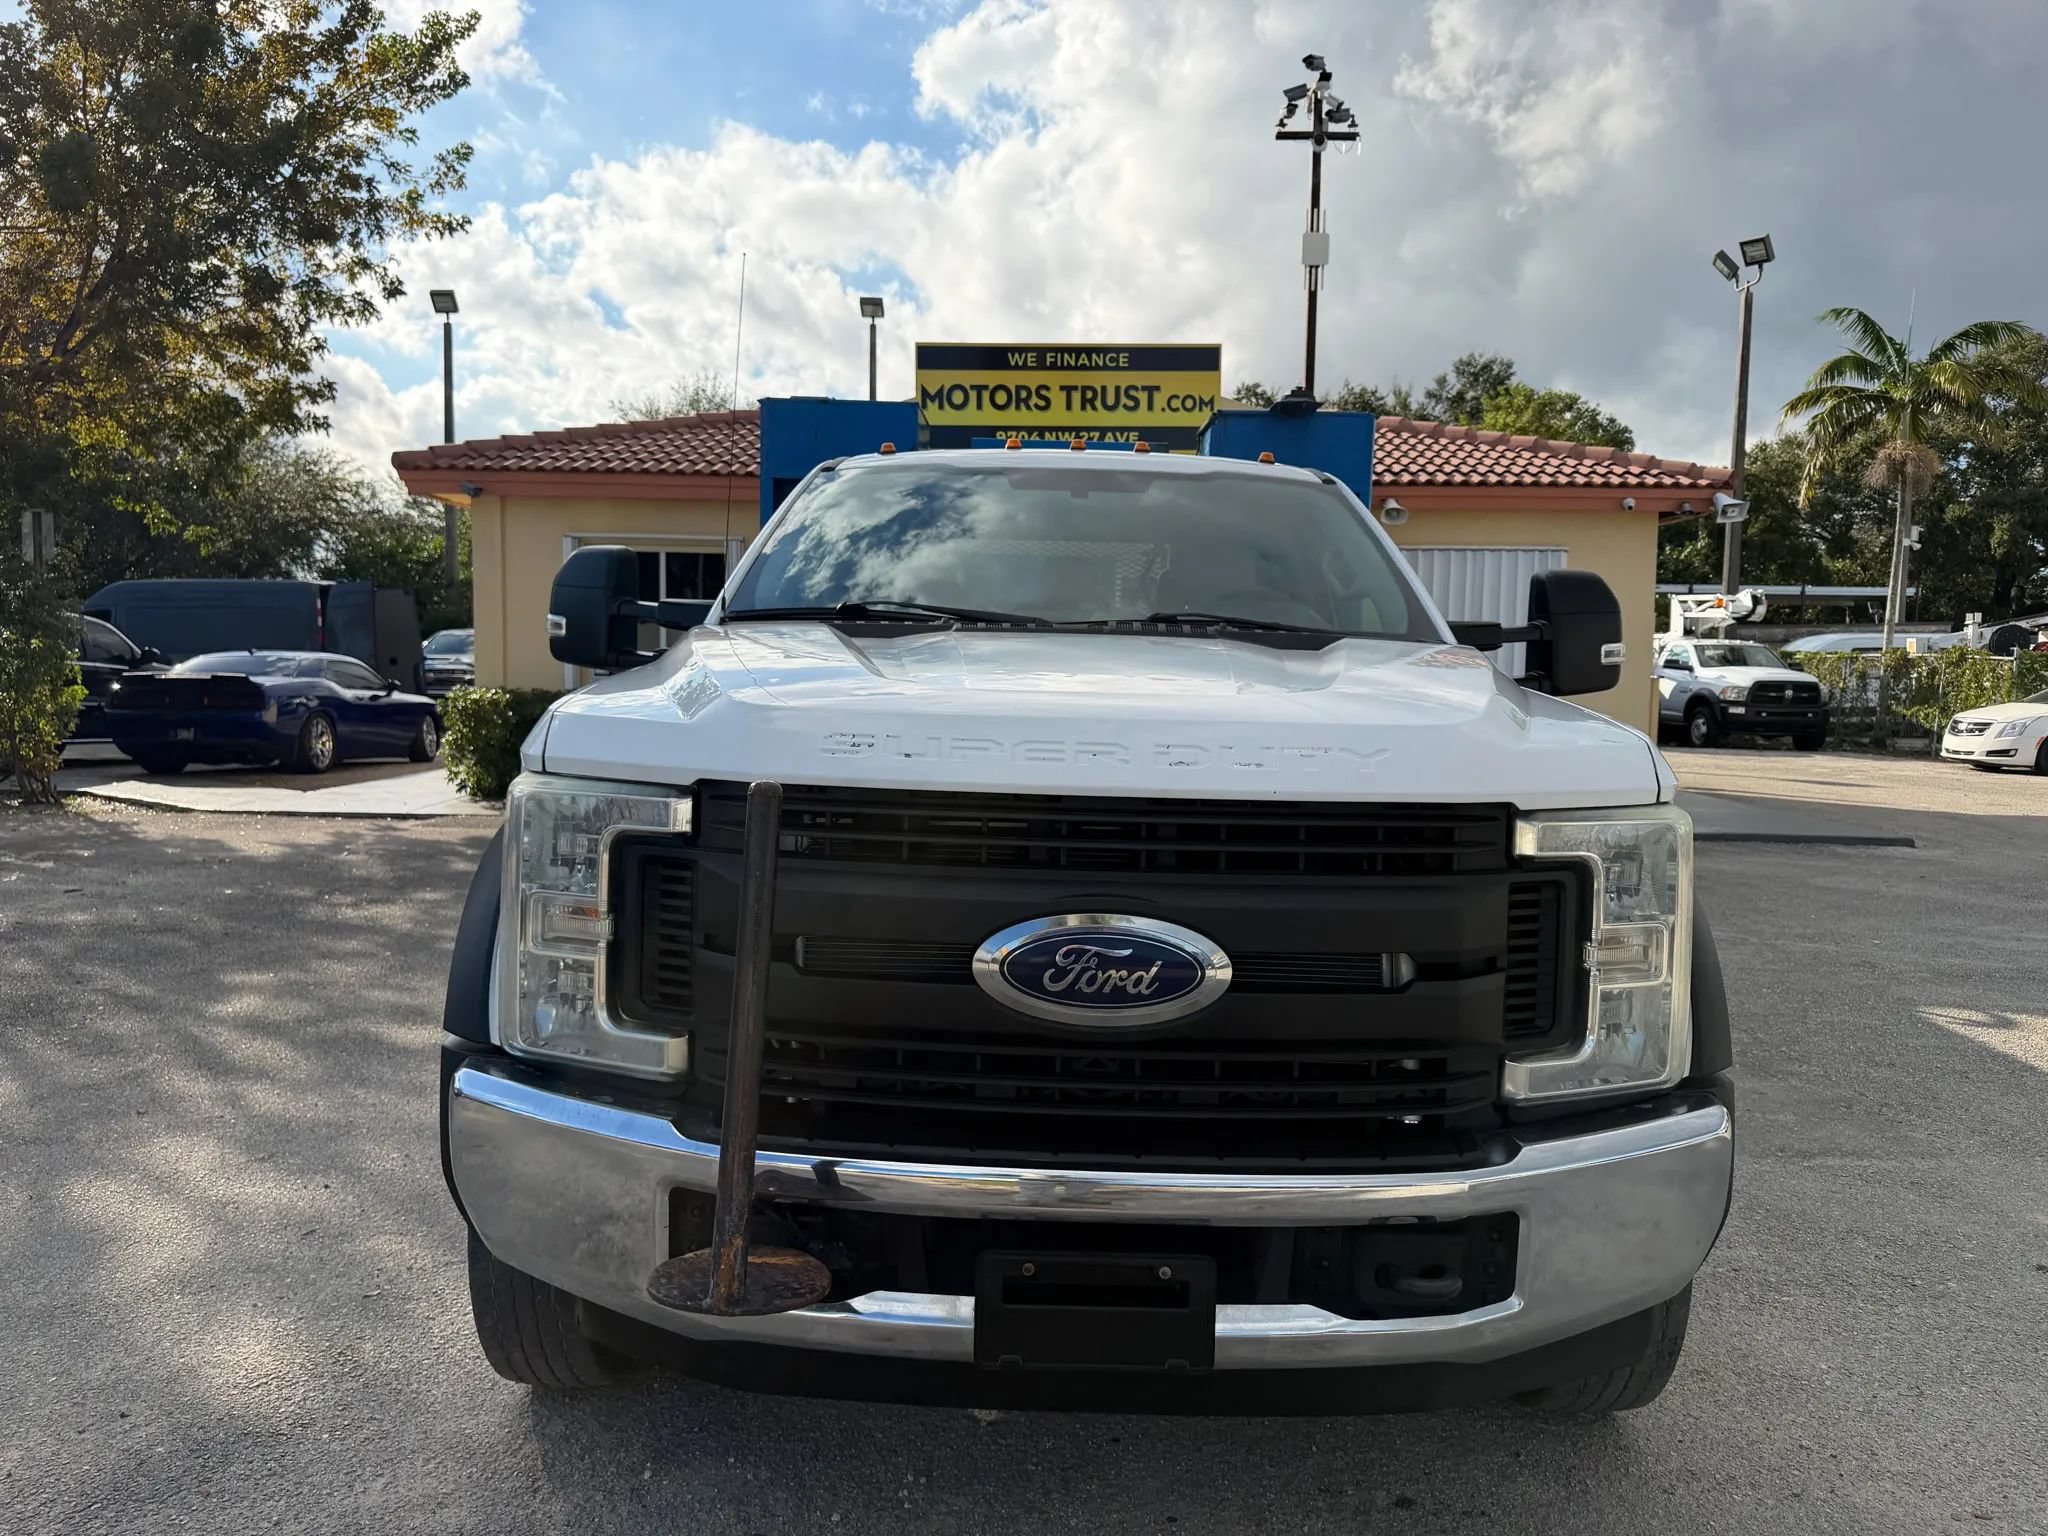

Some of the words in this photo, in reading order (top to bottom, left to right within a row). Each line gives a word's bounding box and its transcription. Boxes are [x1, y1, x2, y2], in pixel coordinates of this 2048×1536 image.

[1007, 352, 1038, 367] WE
[1046, 352, 1130, 367] FINANCE
[920, 383, 1052, 412] MOTORS
[1044, 431, 1076, 441] NW
[1104, 432, 1140, 442] AVE
[820, 732, 1136, 768] SUPER
[1152, 743, 1392, 773] DUTY
[1042, 944, 1163, 995] Ford
